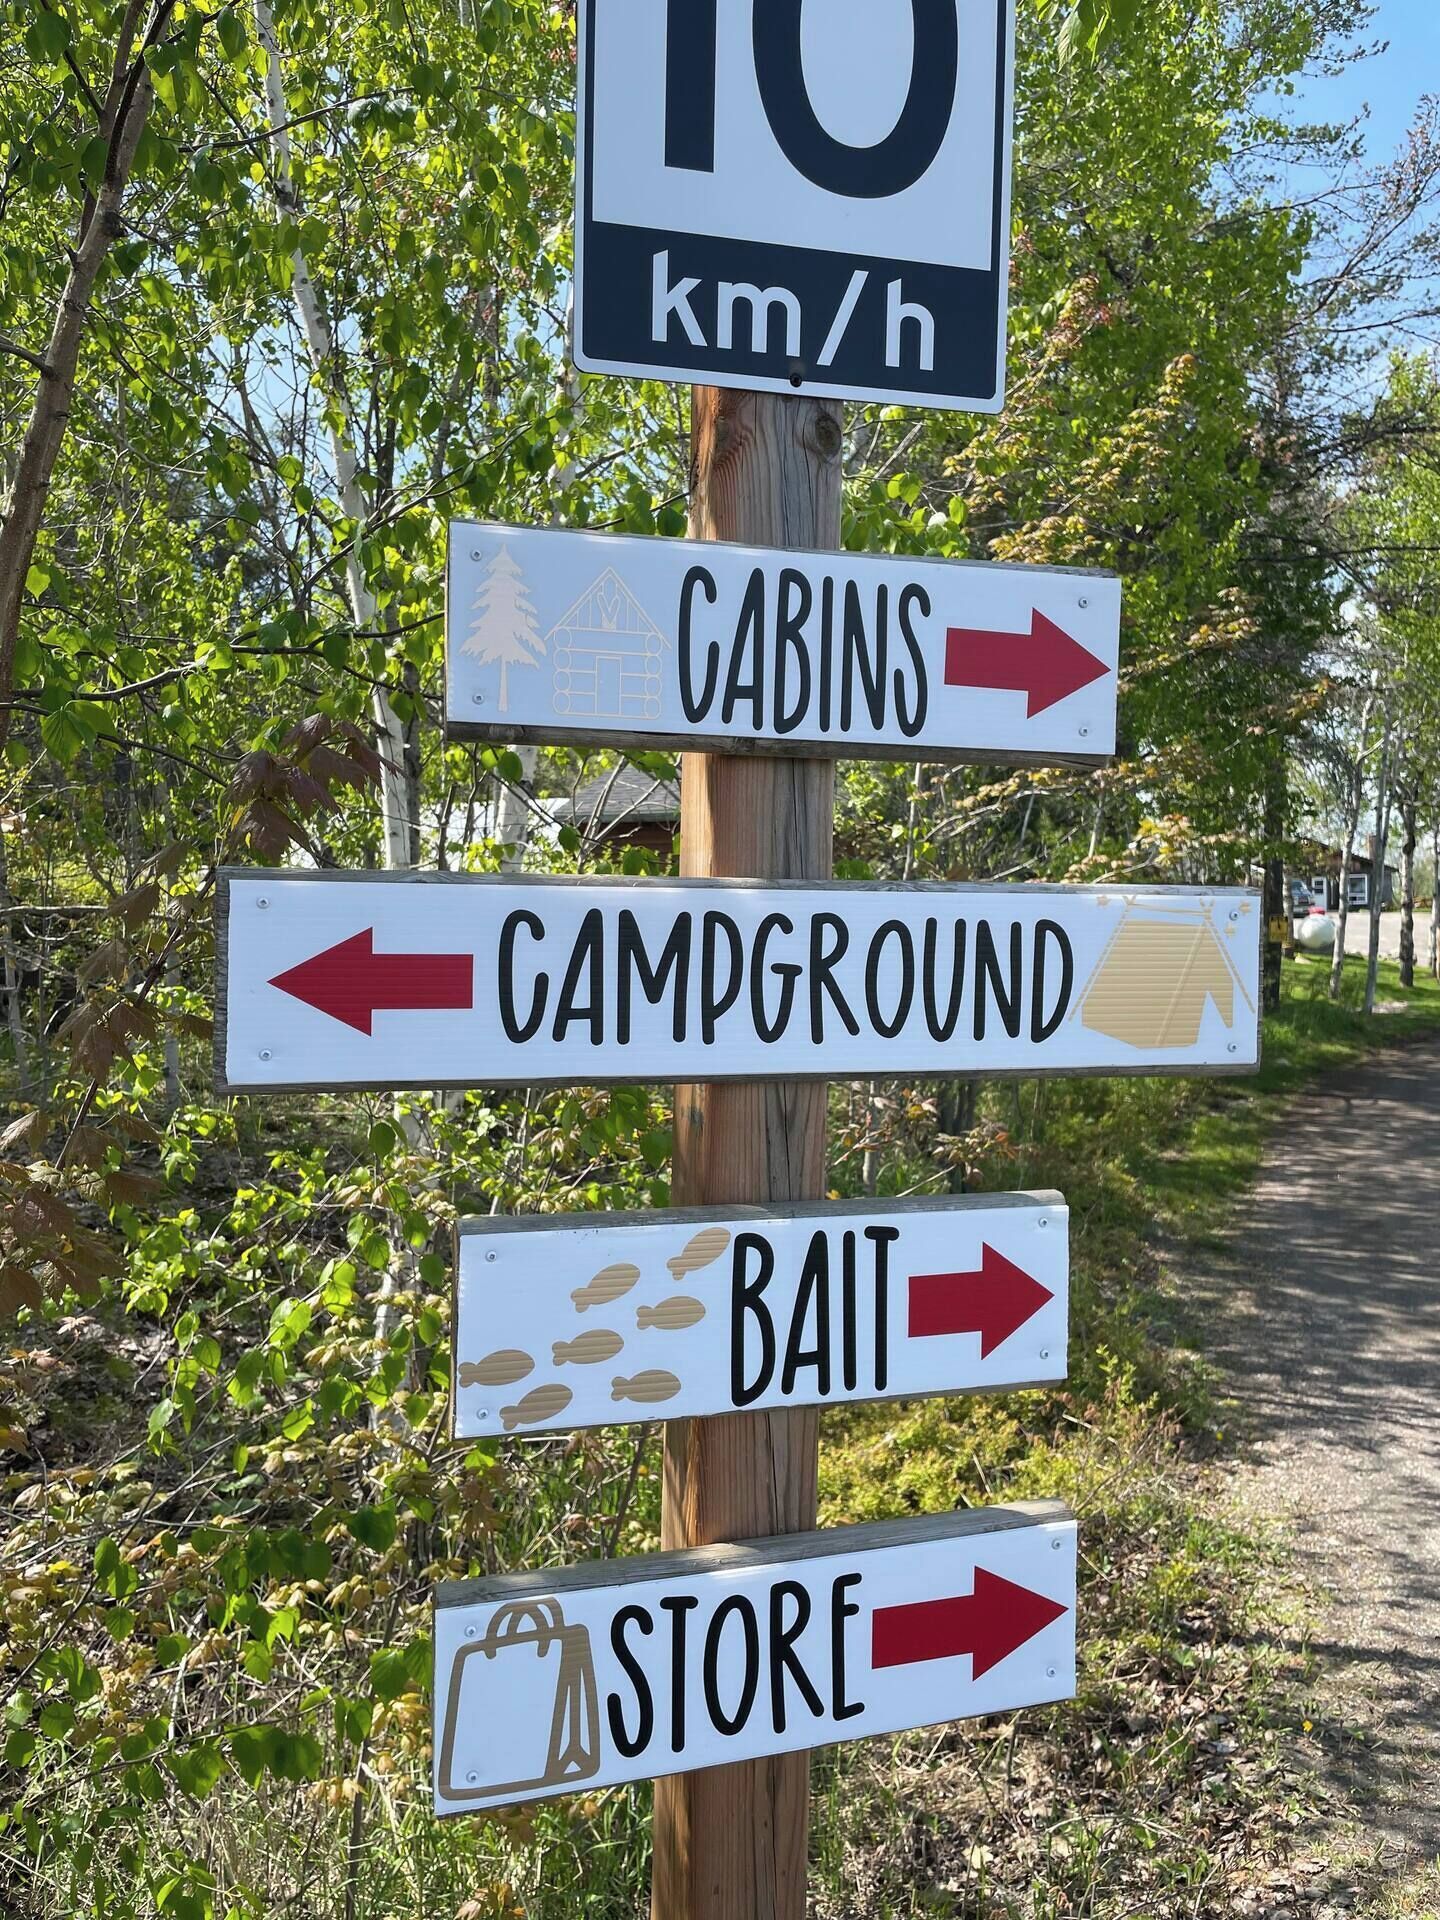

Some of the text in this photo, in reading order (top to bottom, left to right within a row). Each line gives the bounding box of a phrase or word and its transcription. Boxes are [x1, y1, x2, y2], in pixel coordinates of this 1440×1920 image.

[664, 0, 959, 199] 10
[651, 249, 935, 371] km/h
[678, 565, 931, 738] CABINS
[498, 908, 1074, 1046] CAMPGROUND
[730, 1225, 900, 1408] BAIT
[606, 1572, 865, 1758] STORE
